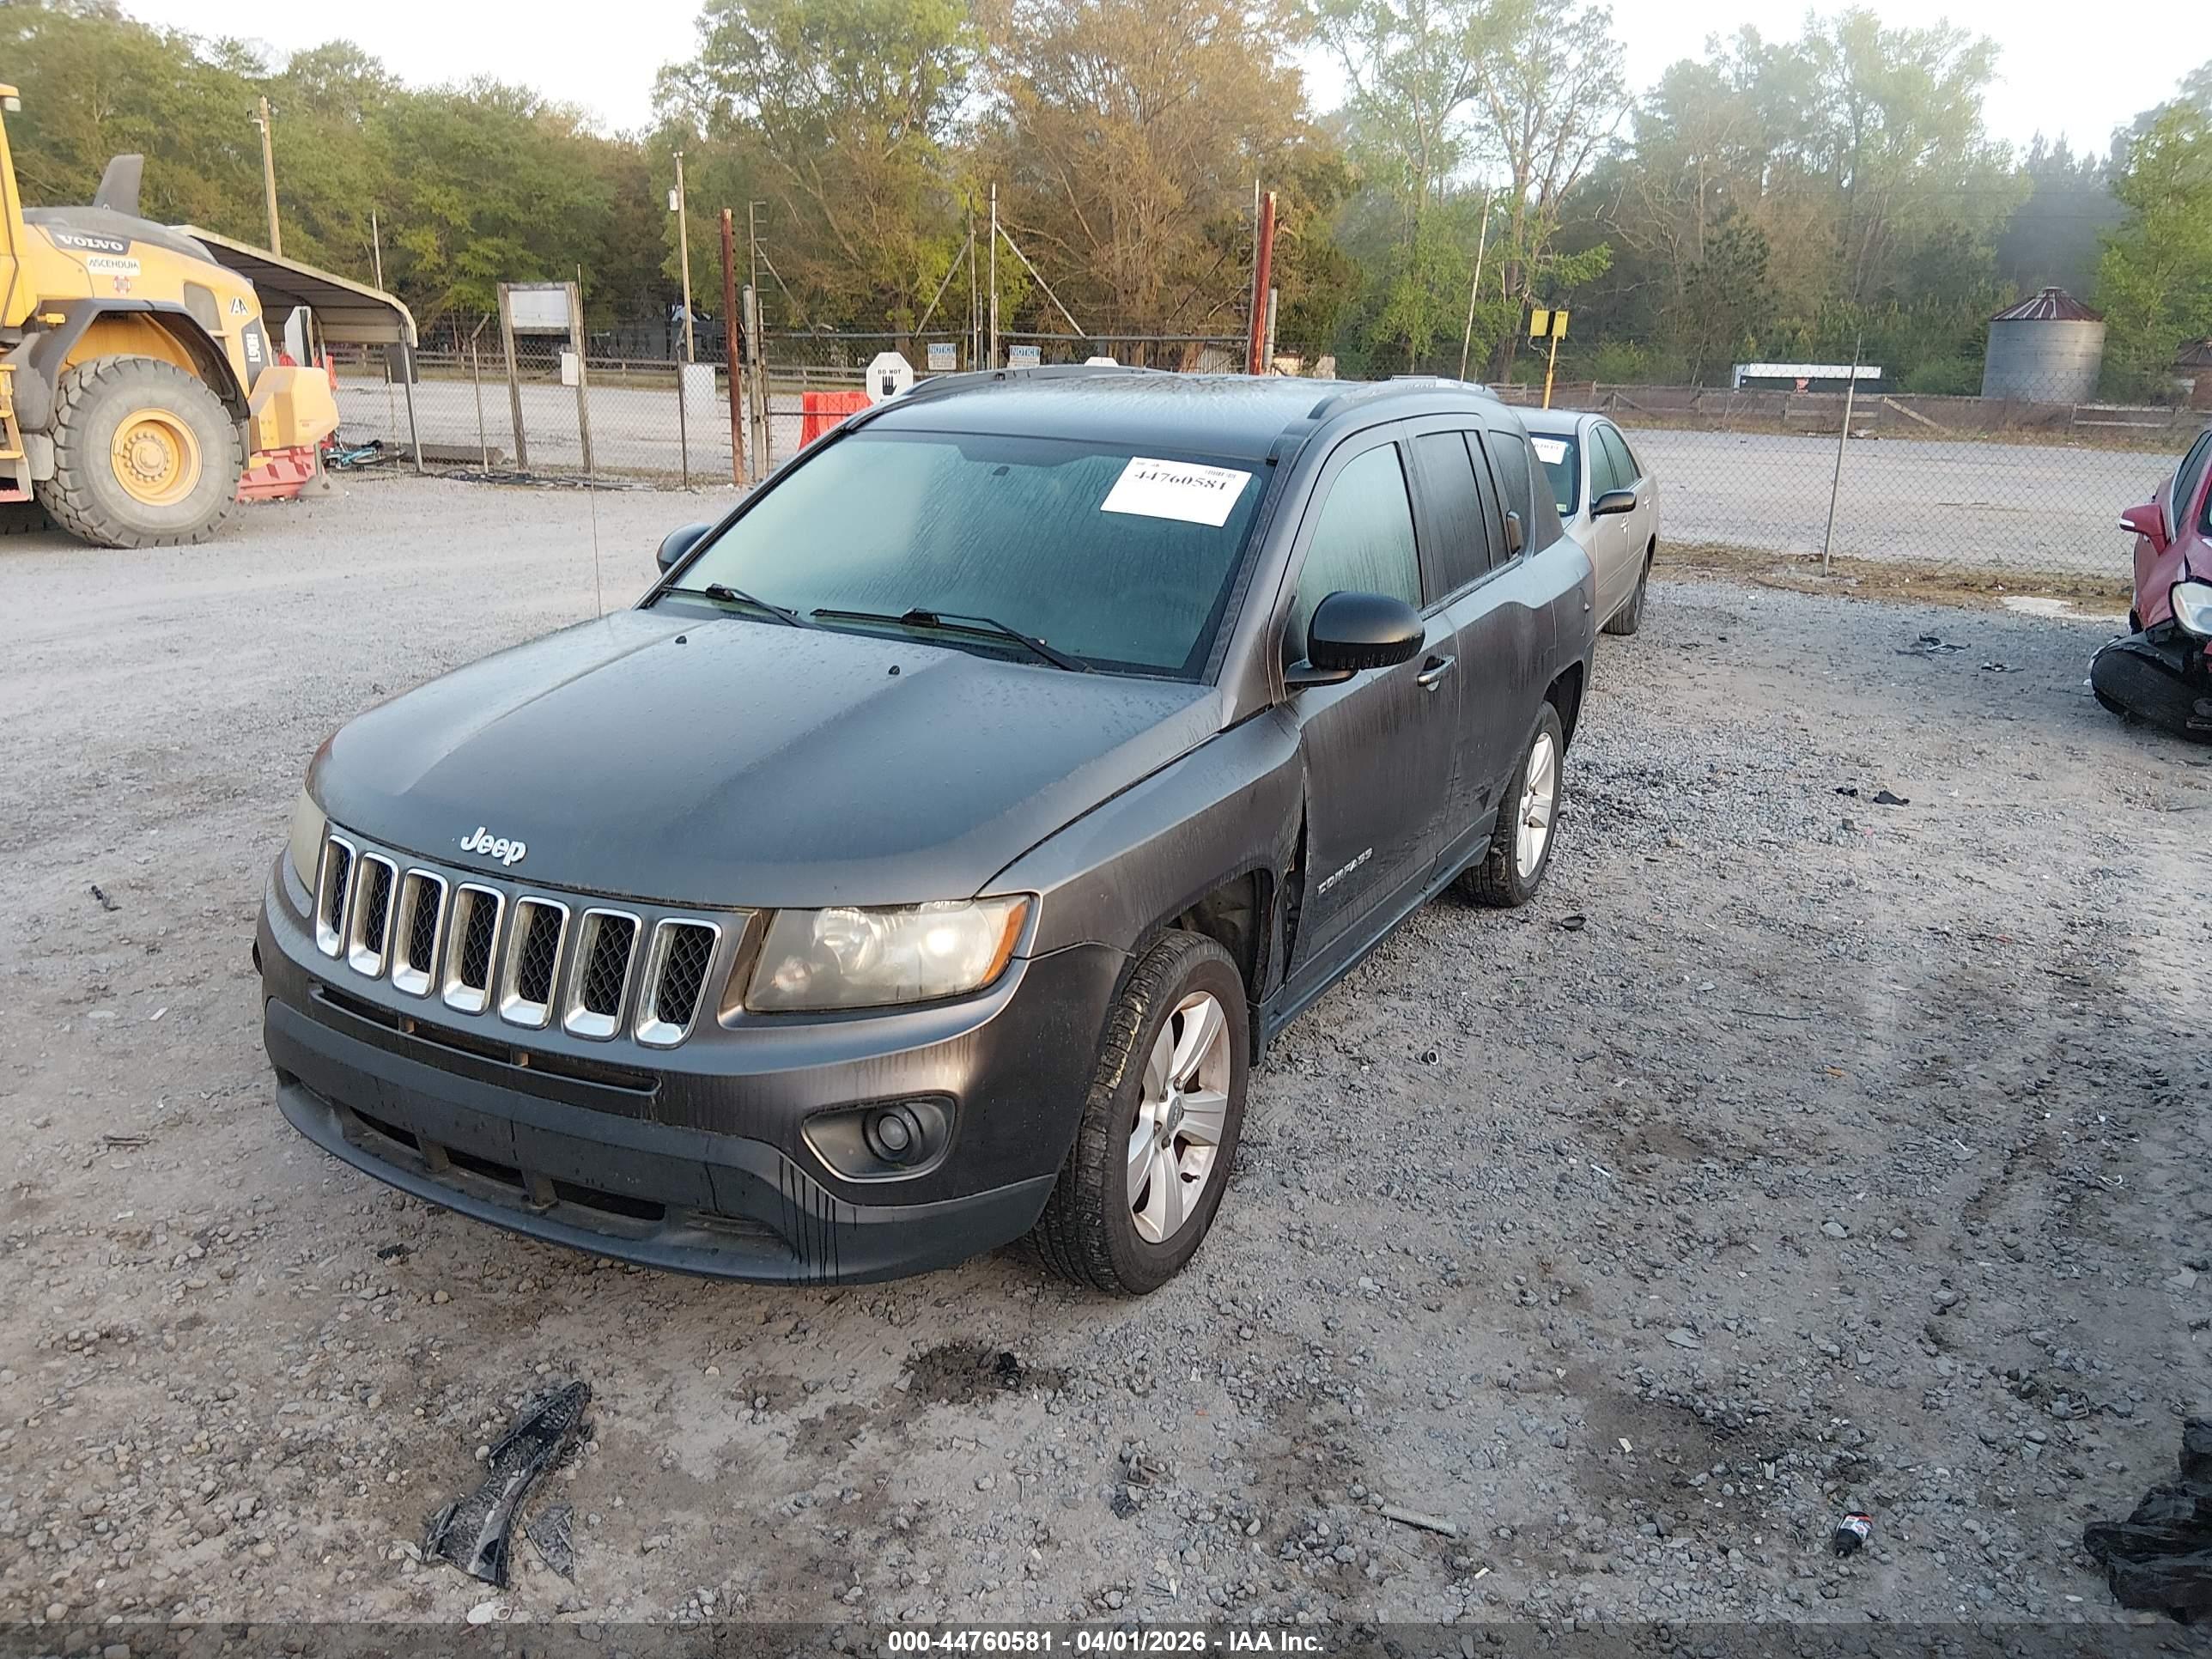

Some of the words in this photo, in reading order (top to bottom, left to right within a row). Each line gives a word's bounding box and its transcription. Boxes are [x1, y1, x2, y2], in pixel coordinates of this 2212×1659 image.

[56, 234, 125, 252] VOLVO
[246, 333, 261, 362] L90H
[928, 344, 956, 354] NOTICE
[1011, 346, 1040, 357] NOTICE
[1134, 470, 1227, 490] 44760581
[460, 826, 526, 866] Jeep
[1318, 847, 1373, 895] COMPASS
